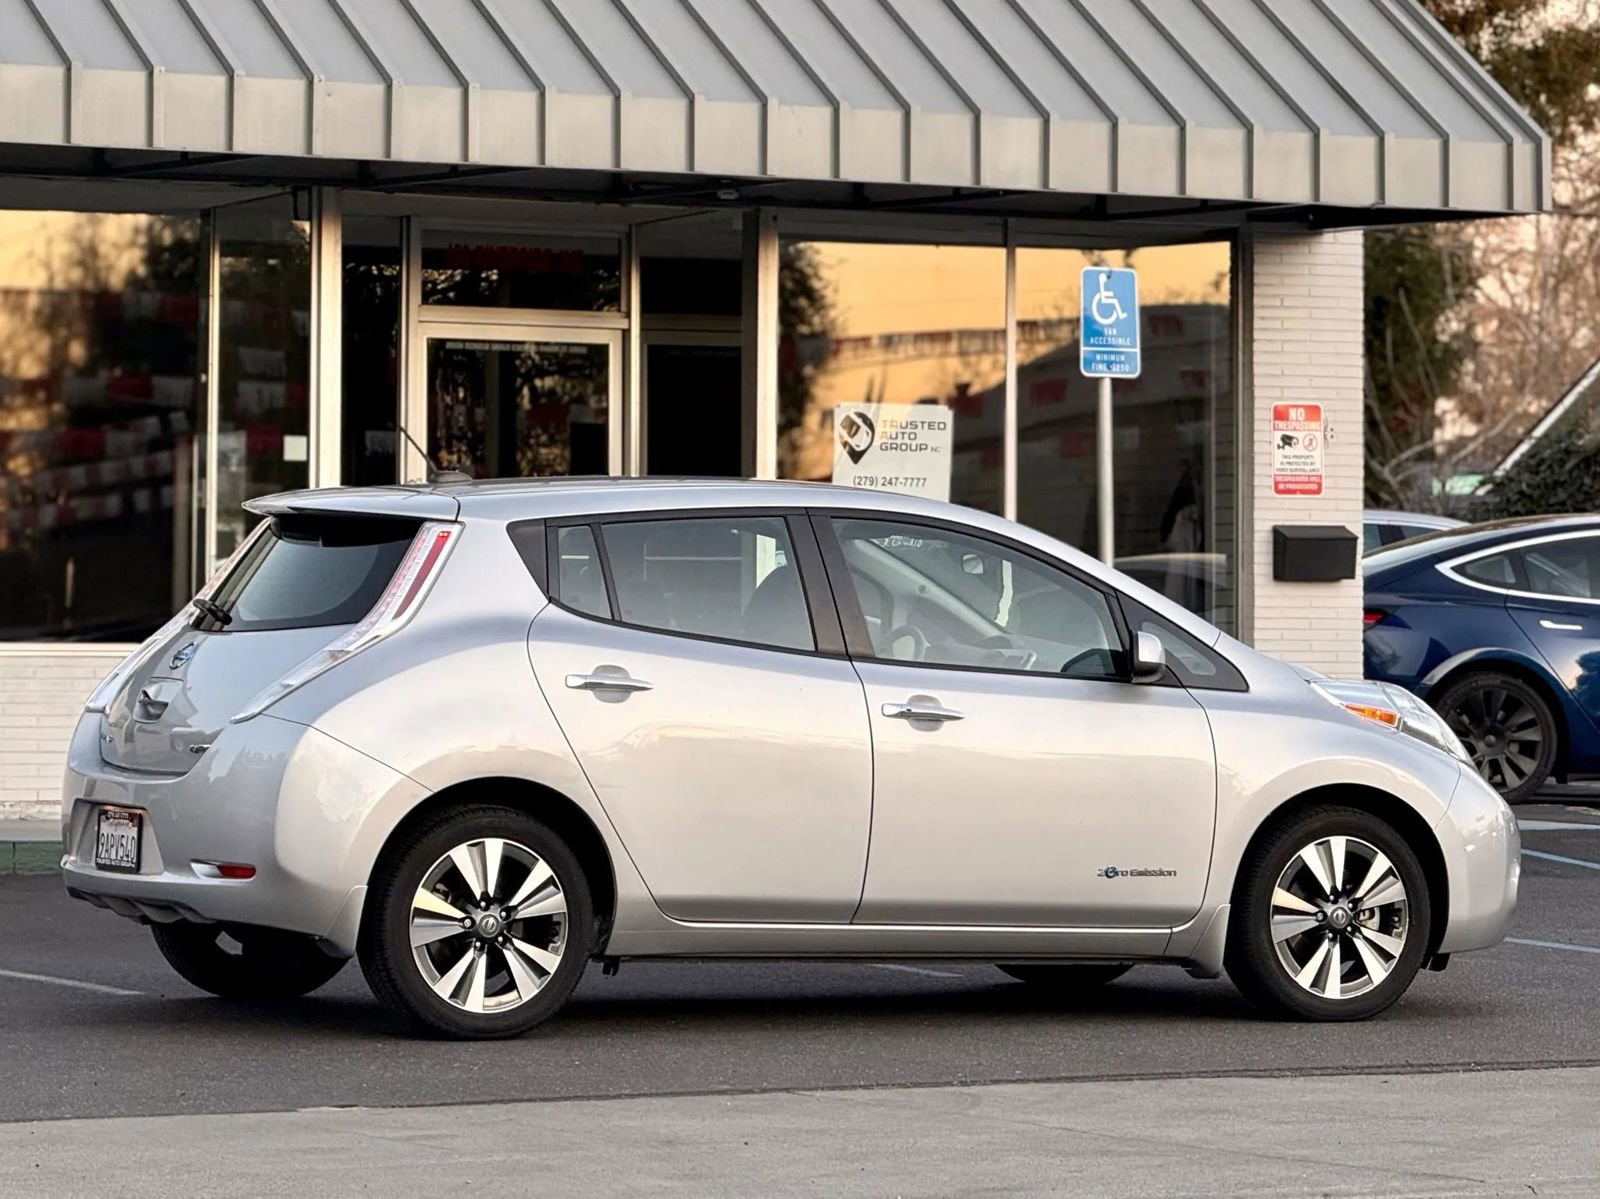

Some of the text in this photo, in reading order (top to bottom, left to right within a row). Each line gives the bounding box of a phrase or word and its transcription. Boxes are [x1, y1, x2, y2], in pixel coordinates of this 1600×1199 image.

[1103, 327, 1117, 336] VAN
[1089, 336, 1131, 345] ACCESSIBLE
[1095, 353, 1125, 362] MINIMUM
[1091, 362, 1107, 371] FINE
[1288, 407, 1306, 420] NO
[880, 420, 947, 431] TRUSTED
[1274, 420, 1321, 431] TRESPASSING
[879, 431, 917, 441] AUTO
[879, 442, 928, 452] GROUP
[853, 476, 927, 488] (279) 247-7777
[1130, 867, 1177, 877] Emission
